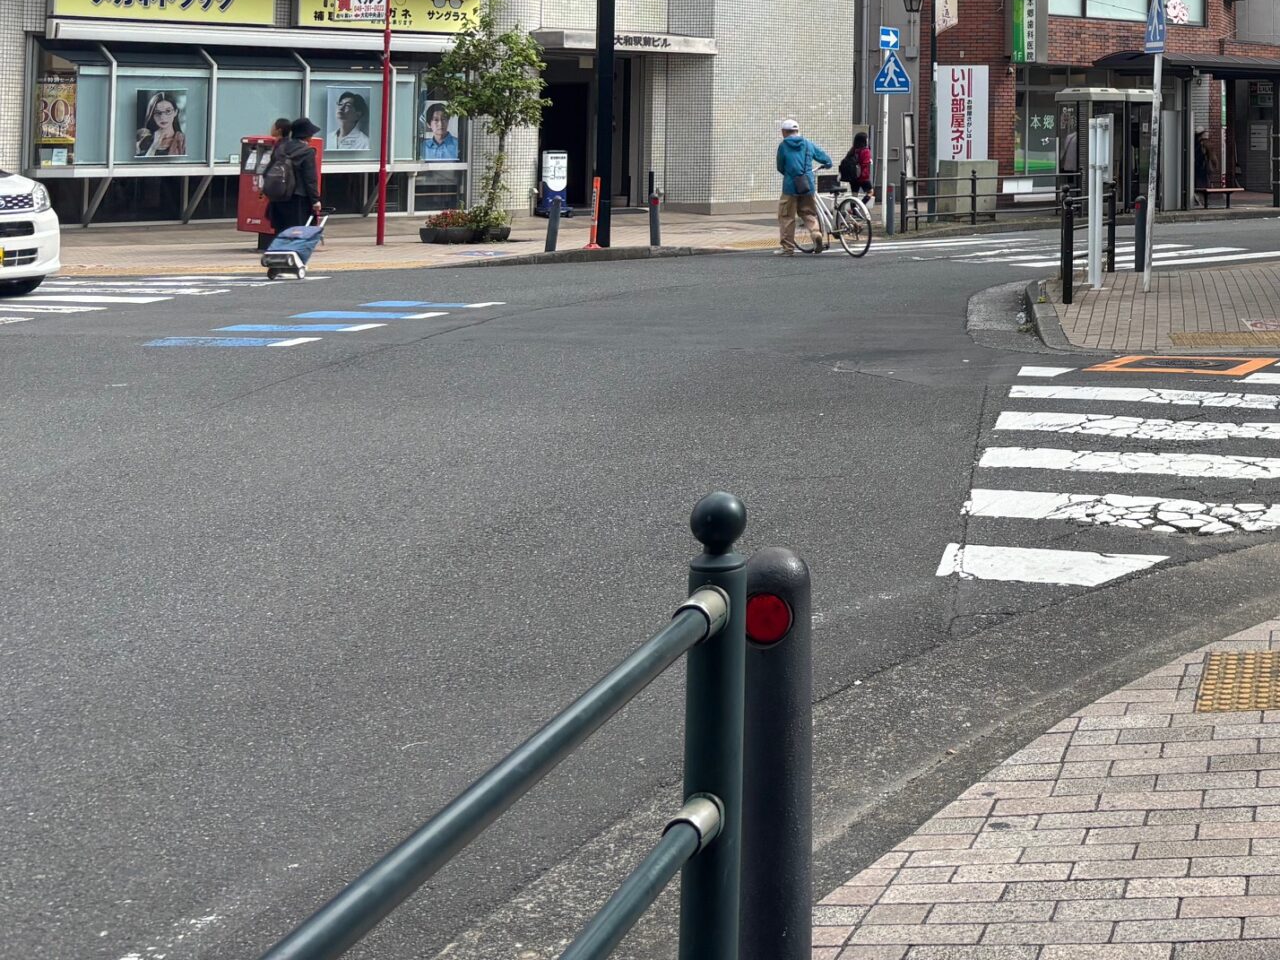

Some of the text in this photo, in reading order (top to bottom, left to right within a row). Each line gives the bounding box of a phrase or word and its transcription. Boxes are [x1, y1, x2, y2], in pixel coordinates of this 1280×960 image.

[950, 67, 965, 160] いい部屋ネッ
[1030, 113, 1055, 130] 本郷
